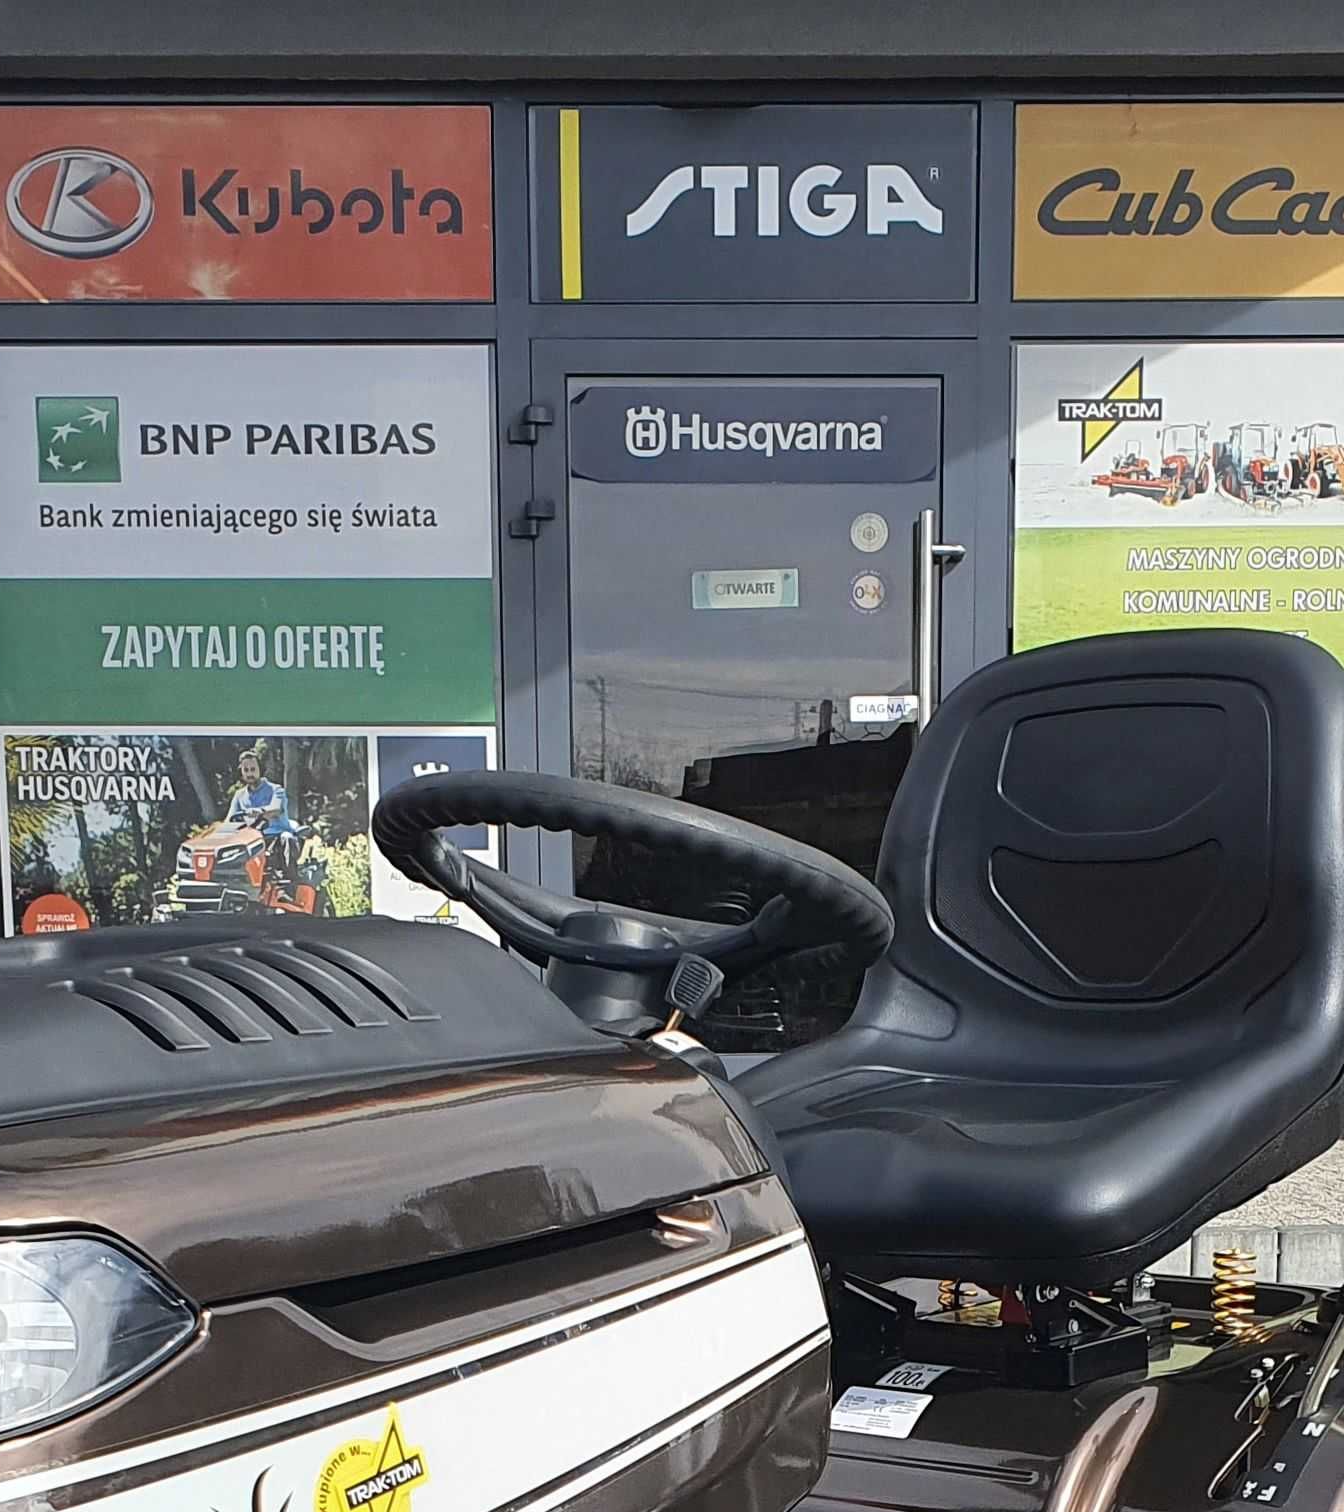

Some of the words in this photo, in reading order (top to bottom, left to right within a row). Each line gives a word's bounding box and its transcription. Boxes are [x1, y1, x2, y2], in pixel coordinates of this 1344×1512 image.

[182, 168, 463, 234] Kubota
[627, 165, 943, 236] STIGA
[1037, 168, 1203, 236] Cub
[1060, 402, 1160, 418] TRAK-TOM
[139, 423, 232, 455] BNP
[246, 423, 436, 455] PARIBAS
[671, 413, 883, 457] Husqvarna
[39, 504, 103, 528] Bank
[112, 504, 298, 535] zmieniającego
[307, 504, 342, 533] się
[352, 503, 438, 528] świata
[1126, 547, 1241, 570] MASZYNY
[714, 582, 776, 595] OTWARTE
[1123, 590, 1270, 613] KOMUNALNE
[101, 625, 238, 669] ZAPYTAJ
[246, 625, 267, 669] O
[274, 624, 386, 676] OFERTĘ
[16, 746, 152, 773] TRAKTORY
[17, 775, 175, 802] HUSQVARNA
